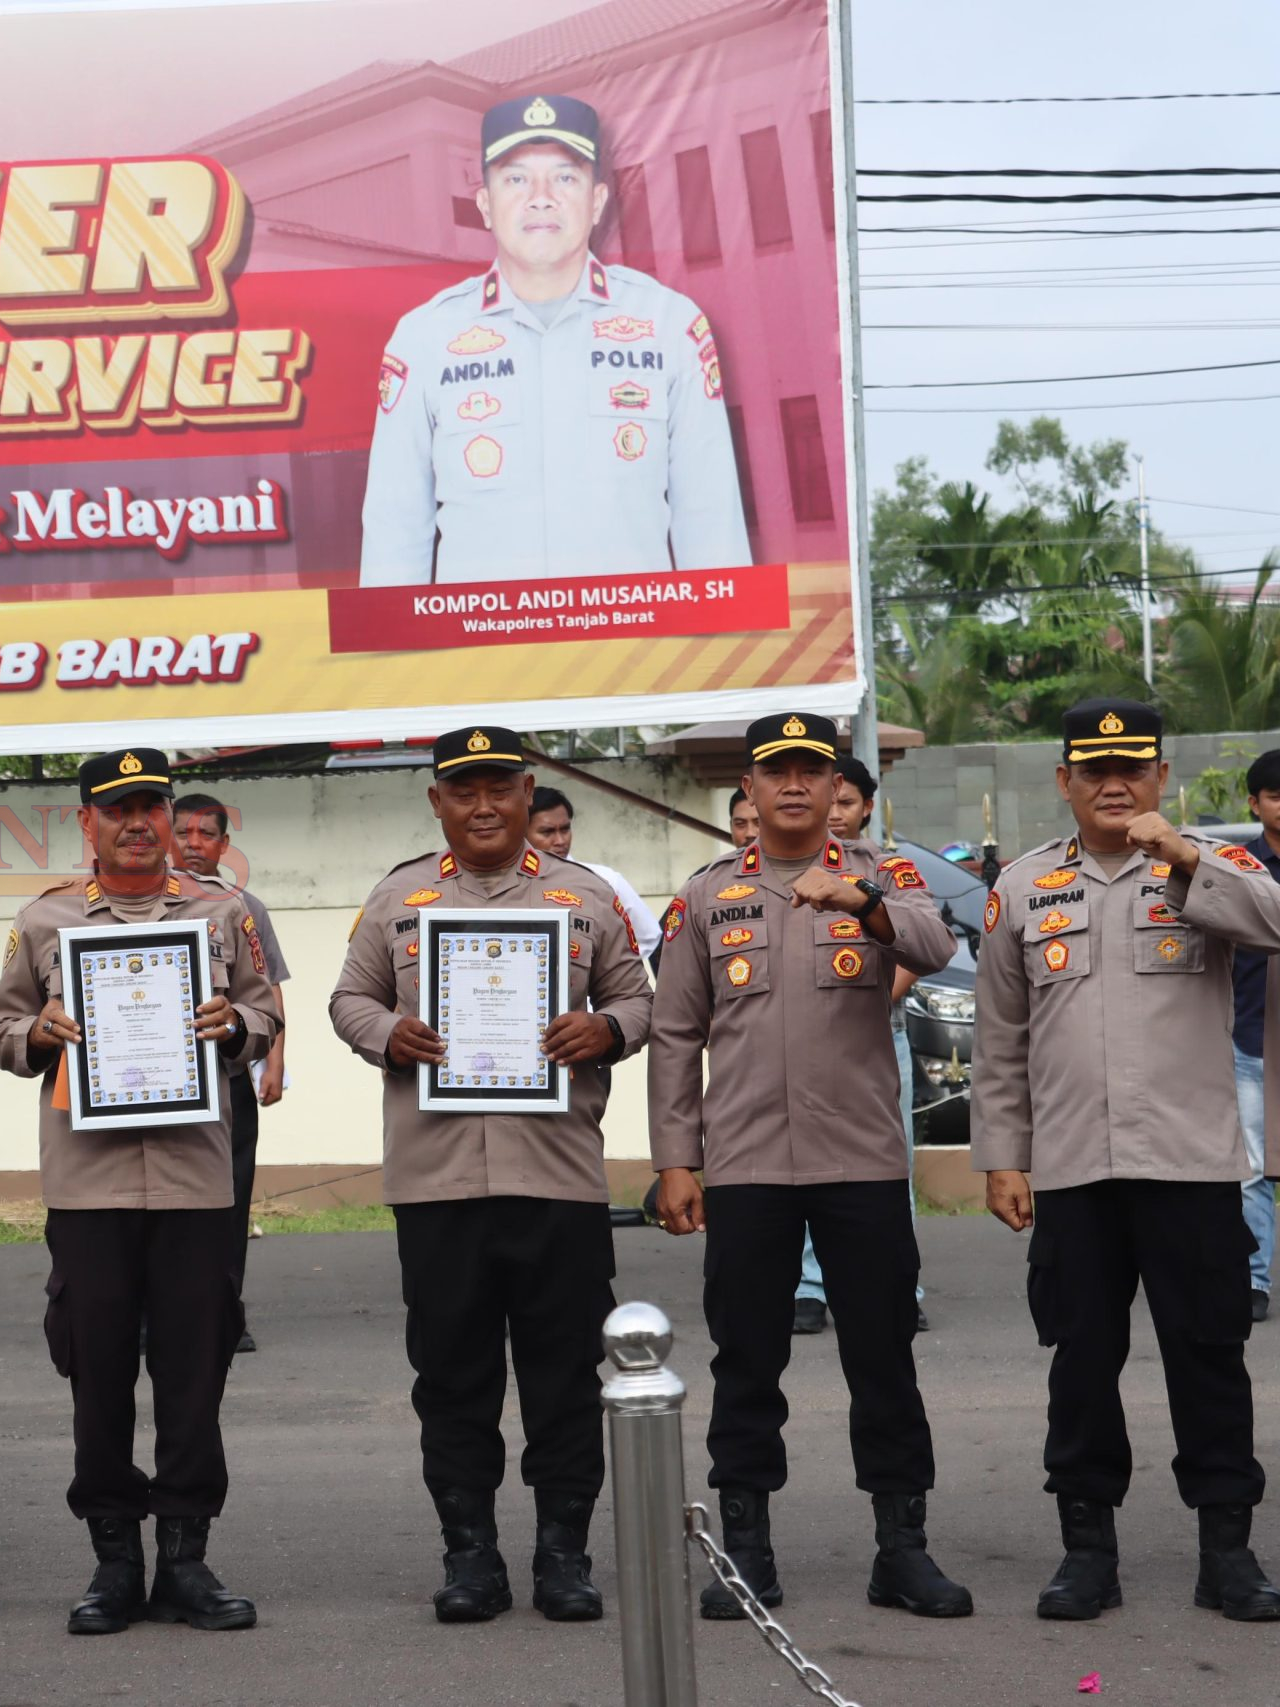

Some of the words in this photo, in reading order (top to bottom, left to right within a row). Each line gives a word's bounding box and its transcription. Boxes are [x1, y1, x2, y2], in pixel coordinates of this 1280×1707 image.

[440, 358, 516, 386] ANDI.M
[591, 350, 664, 371] POLRI
[10, 480, 280, 553] Melayani
[413, 593, 512, 615] KOMPOL
[516, 589, 574, 611] ANDI
[580, 581, 699, 607] MUSAHAR,
[705, 579, 735, 600] SH
[463, 612, 554, 633] Wakapolres
[556, 612, 609, 630] Tanjab
[612, 611, 656, 625] Barat
[56, 632, 254, 683] BARAT
[710, 904, 764, 926] ANDI.M
